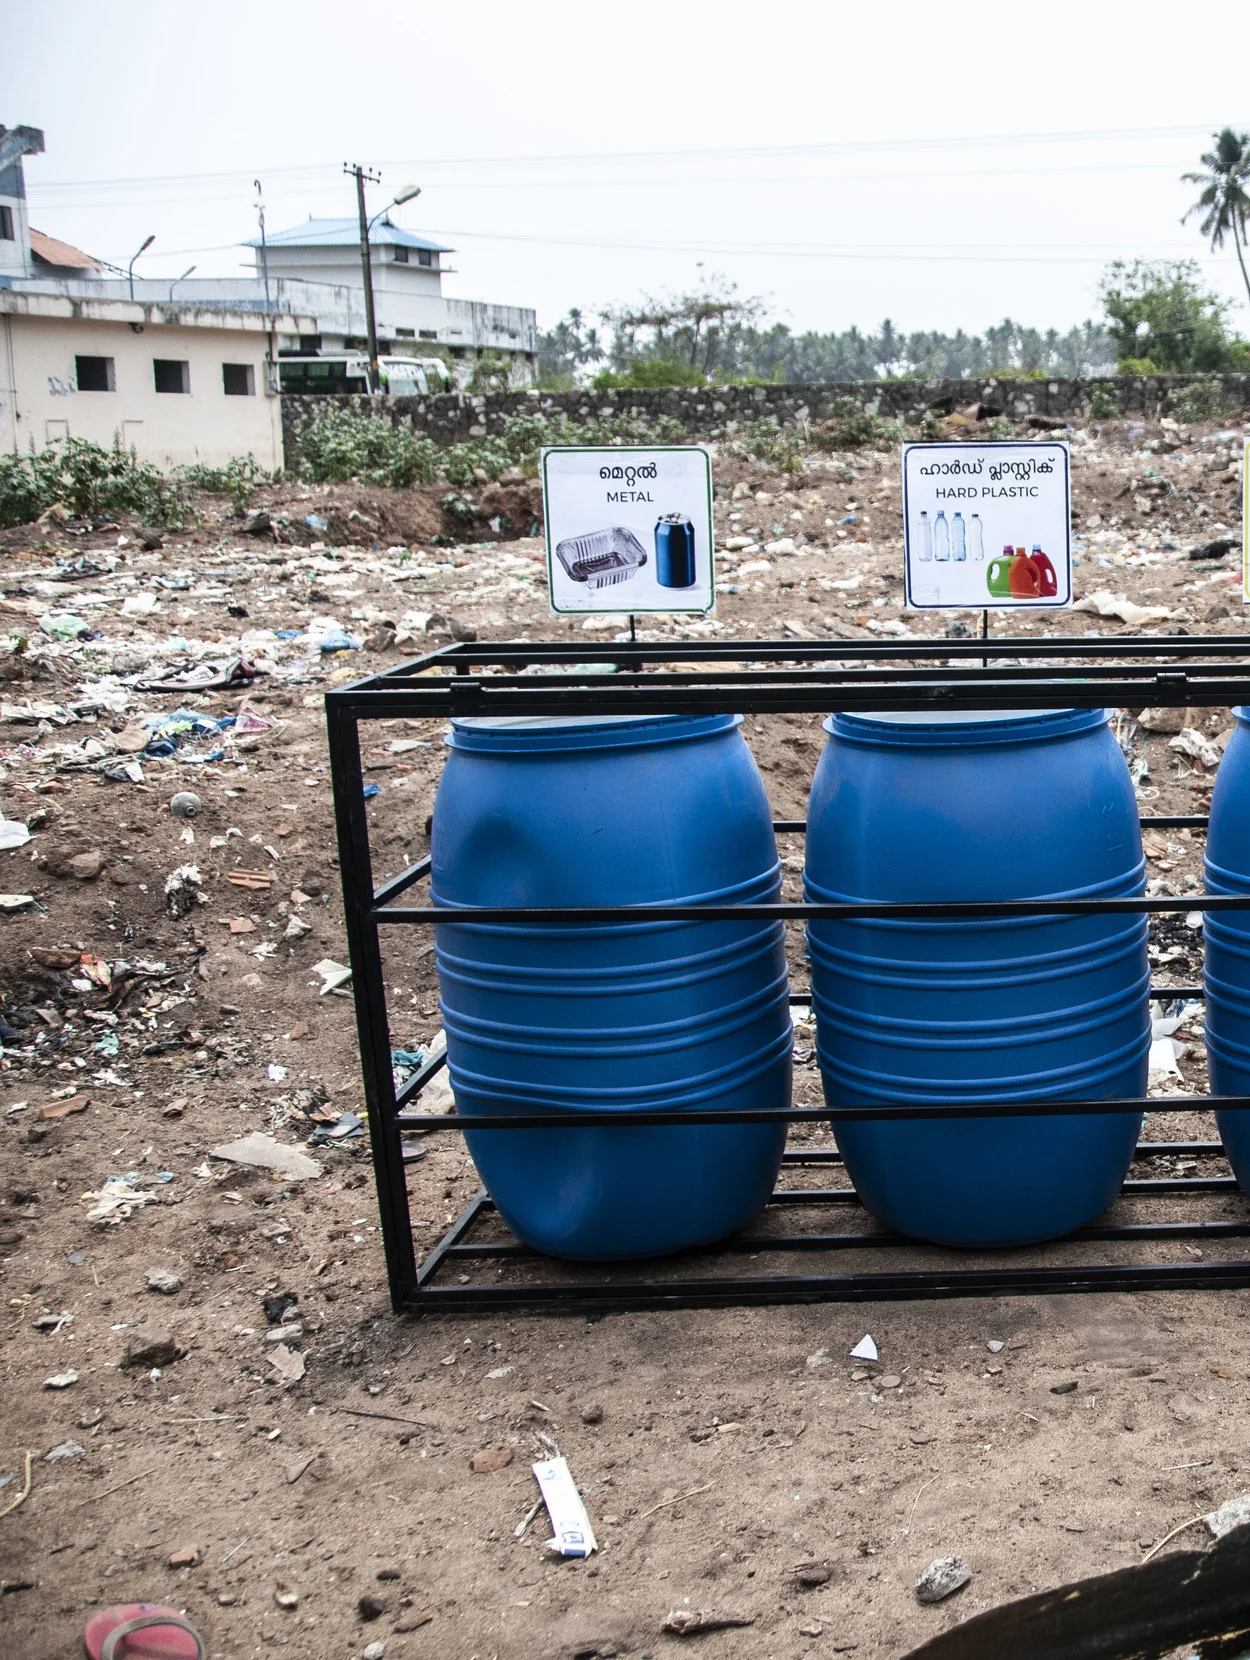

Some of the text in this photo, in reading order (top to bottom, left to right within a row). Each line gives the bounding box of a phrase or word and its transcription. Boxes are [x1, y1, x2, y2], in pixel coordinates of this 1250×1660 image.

[599, 462, 657, 486] മെറ്റൽ
[920, 458, 1055, 481] ഹാർഡ് പ്ലാസ്റ്റിക്
[606, 491, 655, 503] METAL
[936, 486, 1039, 498] HARD PLASTIC
